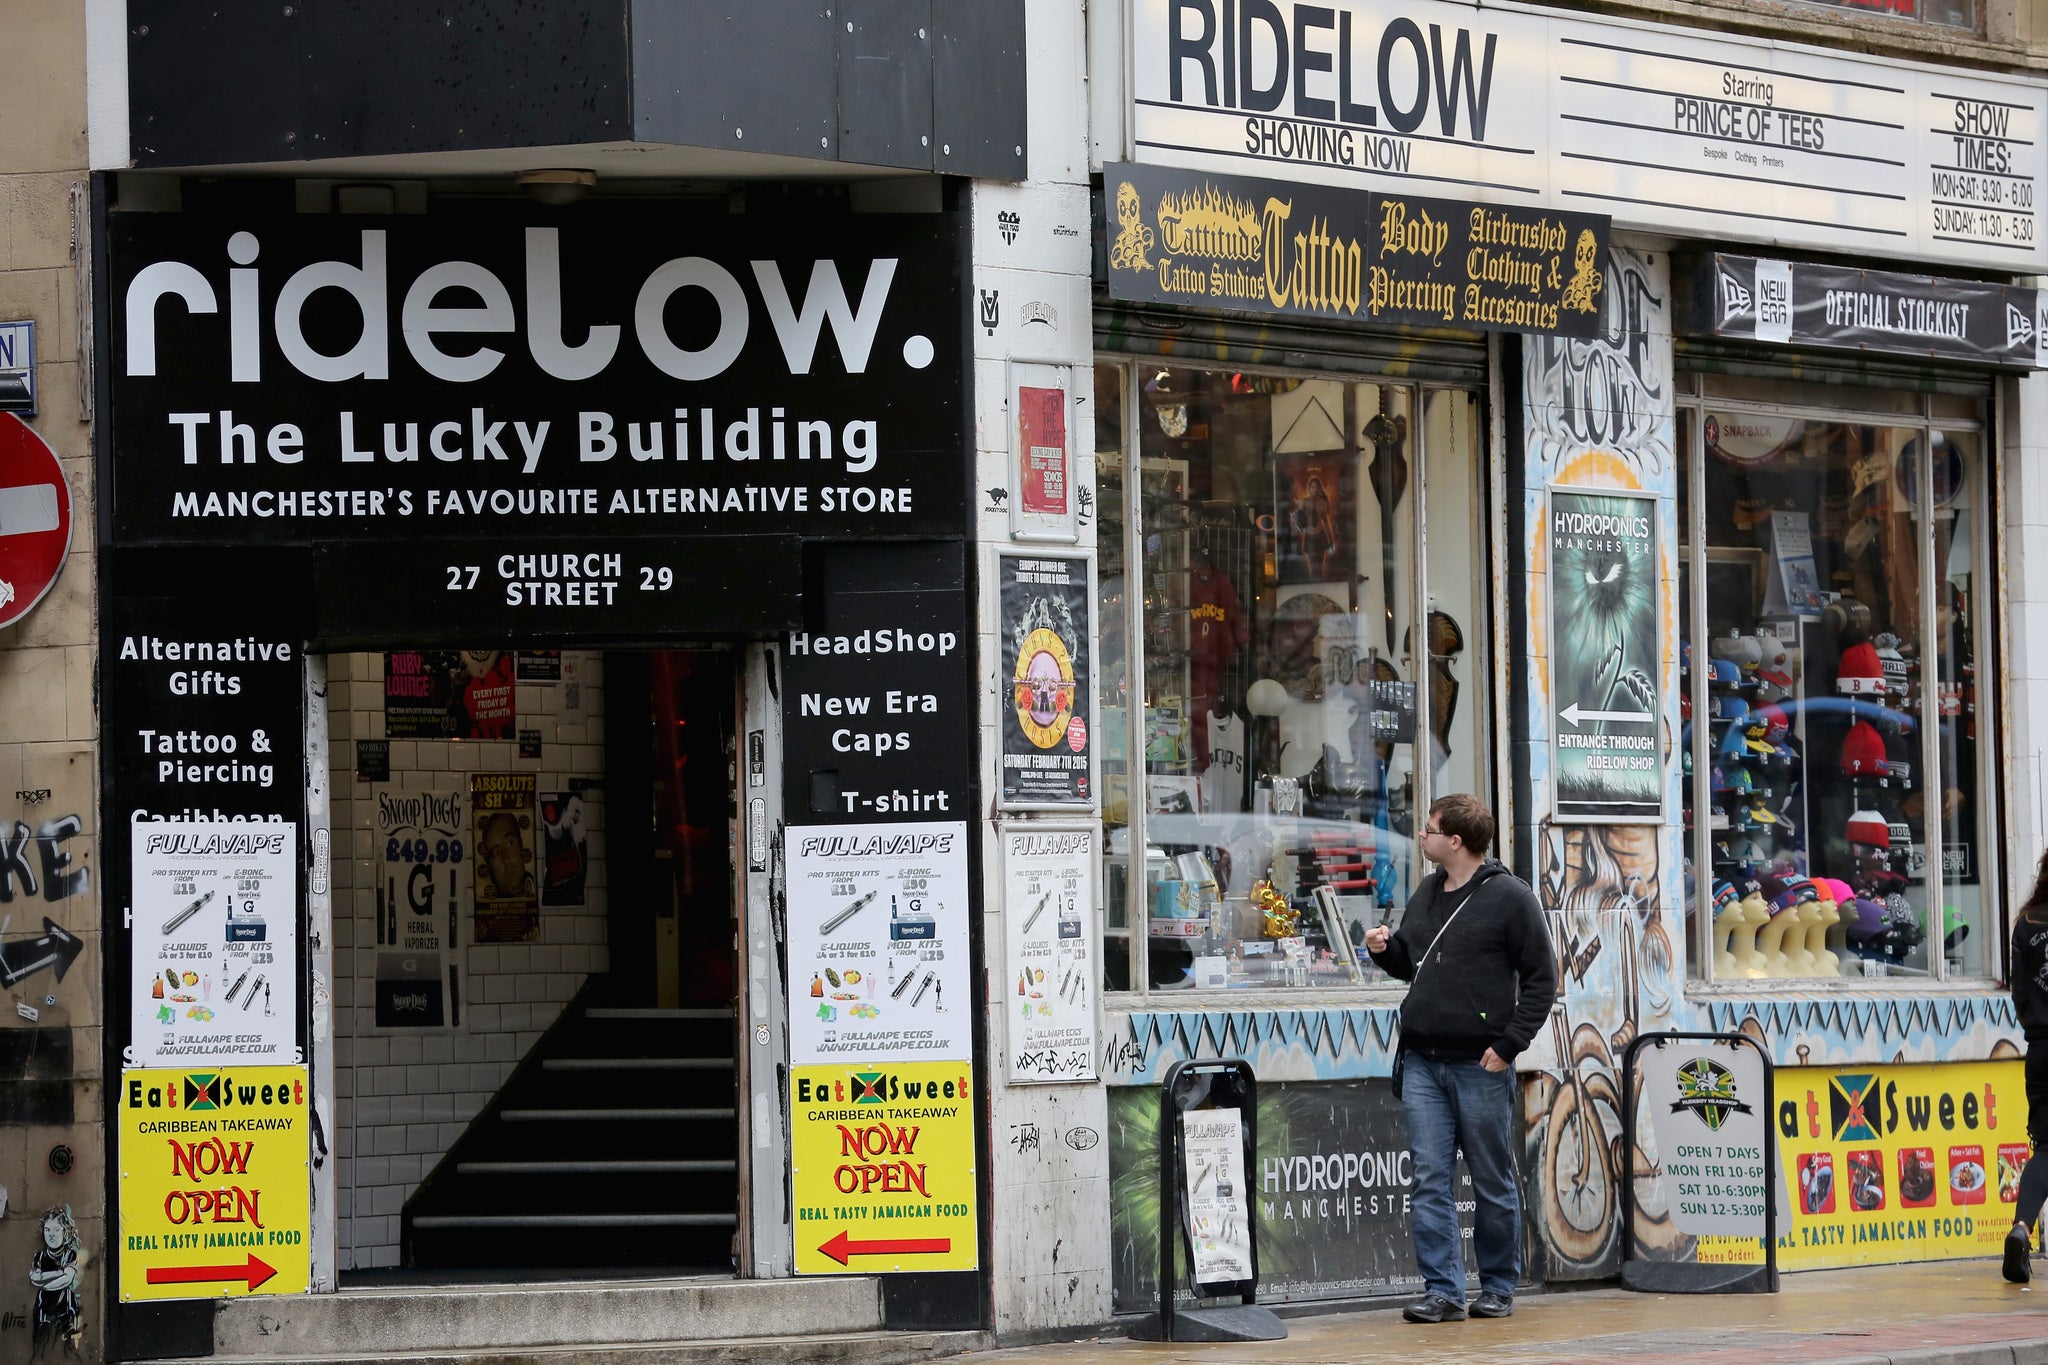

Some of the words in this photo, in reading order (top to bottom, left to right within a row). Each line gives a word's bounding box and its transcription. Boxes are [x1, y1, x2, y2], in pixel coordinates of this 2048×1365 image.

[1169, 0, 1498, 141] RIDELOW
[1723, 71, 1774, 106] Starring
[1675, 97, 1742, 138] PRINCE
[1747, 108, 1771, 141] OF
[1778, 112, 1824, 150] TEES
[1954, 100, 2010, 137] SHOW
[1245, 118, 1354, 166] SHOWING
[1364, 136, 1412, 173] NOW
[1704, 147, 1728, 161] Bespoke
[1734, 150, 1758, 166] Clothing
[1762, 154, 1784, 169] Printers
[1953, 137, 2012, 174] TIMES:
[1932, 172, 1979, 201] MON-SAT:
[1982, 179, 2002, 204] 9.30
[2012, 183, 2033, 208] 6.00
[1380, 200, 1449, 268] Body
[1469, 206, 1568, 253] Airbrushed
[1933, 208, 1976, 235] SUNDAY:
[1979, 214, 2002, 238] 11.30
[2012, 217, 2033, 241] 5.30
[1162, 216, 1262, 263] Tattitude
[1263, 197, 1361, 316] Tattoo
[1158, 258, 1206, 294] Tattoo
[1210, 262, 1265, 300] Studios
[1466, 247, 1541, 294] Clothing
[1546, 257, 1563, 290] &
[1369, 266, 1456, 322] Piercing
[1760, 279, 1787, 300] NEW
[1463, 282, 1558, 330] Accesories
[1760, 302, 1787, 323] ERA
[1825, 289, 1892, 332] OFFICIAL
[1897, 297, 1970, 339] STOCKIST
[169, 409, 303, 465] The
[340, 407, 550, 473] Lucky
[579, 407, 877, 472] Building
[172, 487, 413, 517] MANCHESTER'S
[427, 489, 597, 515] FAVOURITE
[608, 487, 807, 514] ALTERNATIVE
[820, 487, 912, 513] STORE
[1555, 512, 1649, 539] HYDROPONICS
[1555, 537, 1650, 554] MANCHESTER
[446, 566, 480, 591] 27
[498, 553, 621, 579] CHURCH
[639, 566, 673, 592] 29
[506, 581, 618, 606] STREET
[120, 636, 291, 661] Alternative
[789, 628, 957, 656] HeadShop
[391, 653, 424, 675] RUBY
[169, 671, 242, 695] Gifts
[386, 676, 430, 698] LOUNGE
[473, 688, 493, 700] EVERY
[493, 686, 511, 697] FIRST
[475, 710, 488, 720] THE
[489, 708, 511, 719] MONTH
[477, 699, 499, 710] FRIDAY
[499, 697, 508, 707] OF
[801, 693, 871, 717] New
[886, 690, 938, 714] Era
[139, 730, 237, 754] Tattoo
[251, 729, 272, 753] &
[831, 728, 911, 757] Caps
[1558, 732, 1608, 749] ENTRANCE
[1608, 734, 1654, 750] THROUGH
[159, 759, 274, 788] Piercing
[1004, 754, 1032, 768] SATURDAY
[1032, 755, 1061, 769] FEBRUARY
[1061, 756, 1072, 769] 7TH
[1072, 756, 1087, 770] 2015
[1587, 755, 1628, 770] RIDELOW
[1630, 756, 1654, 770] SHOP
[474, 776, 534, 792] ABSOLUTE
[378, 791, 422, 829] SNOOP
[422, 791, 461, 829] DOGG
[841, 789, 949, 813] T-shirt
[146, 833, 285, 855] FULLAVAPE
[386, 838, 463, 863] £49.99
[801, 833, 954, 857] FULLAVAPE
[1943, 851, 1965, 861] NEW
[1943, 861, 1965, 870] ERA
[407, 922, 434, 935] HERBAL
[222, 943, 245, 951] MOD
[250, 942, 273, 951] KITS
[404, 937, 439, 950] VAPORIZER
[887, 941, 912, 950] MOD
[918, 940, 943, 949] KITS
[178, 1035, 233, 1043] FULLAVAPE
[235, 1034, 262, 1042] ECIGS
[841, 1032, 901, 1041] FULLAVAPE
[903, 1030, 933, 1039] ECIGS
[129, 1080, 177, 1109] Eat
[197, 1082, 208, 1103] &
[223, 1077, 303, 1106] Sweet
[798, 1078, 844, 1103] Eat
[862, 1080, 875, 1097] &
[890, 1075, 968, 1100] Sweet
[808, 1108, 884, 1122] CARIBBEAN
[887, 1107, 958, 1119] TAKEAWAY
[1779, 1089, 1821, 1139] at
[1848, 1089, 1866, 1128] &
[1885, 1080, 1998, 1135] Sweet
[139, 1120, 217, 1134] CARIBBEAN
[221, 1118, 293, 1132] TAKEAWAY
[837, 1122, 920, 1161] NOW
[1677, 1145, 1712, 1158] OPEN
[1715, 1147, 1722, 1158] 7
[1727, 1147, 1760, 1159] DAYS
[168, 1136, 254, 1182] NOW
[1667, 1164, 1700, 1176] MON
[1705, 1166, 1725, 1177] FRI
[1728, 1166, 1765, 1178] 10-6P
[834, 1160, 932, 1198] OPEN
[1263, 1150, 1413, 1194] HYDROPONIC
[1678, 1184, 1701, 1195] SAT
[164, 1186, 265, 1229] OPEN
[800, 1207, 829, 1221] REAL
[833, 1206, 868, 1220] TASTY
[873, 1204, 931, 1220] JAMAICAN
[936, 1204, 968, 1217] FOOD
[1264, 1193, 1411, 1221] MANCHESTE
[1680, 1202, 1707, 1214] SUN
[1711, 1203, 1765, 1216] 12-5:30P
[128, 1236, 158, 1250] REAL
[163, 1234, 199, 1250] TASTY
[203, 1231, 264, 1249] JAMAICAN
[269, 1230, 301, 1246] FOOD
[1801, 1225, 1845, 1247] TASTY
[1852, 1219, 1927, 1245] JAMAICAN
[1934, 1217, 1973, 1238] FOOD
